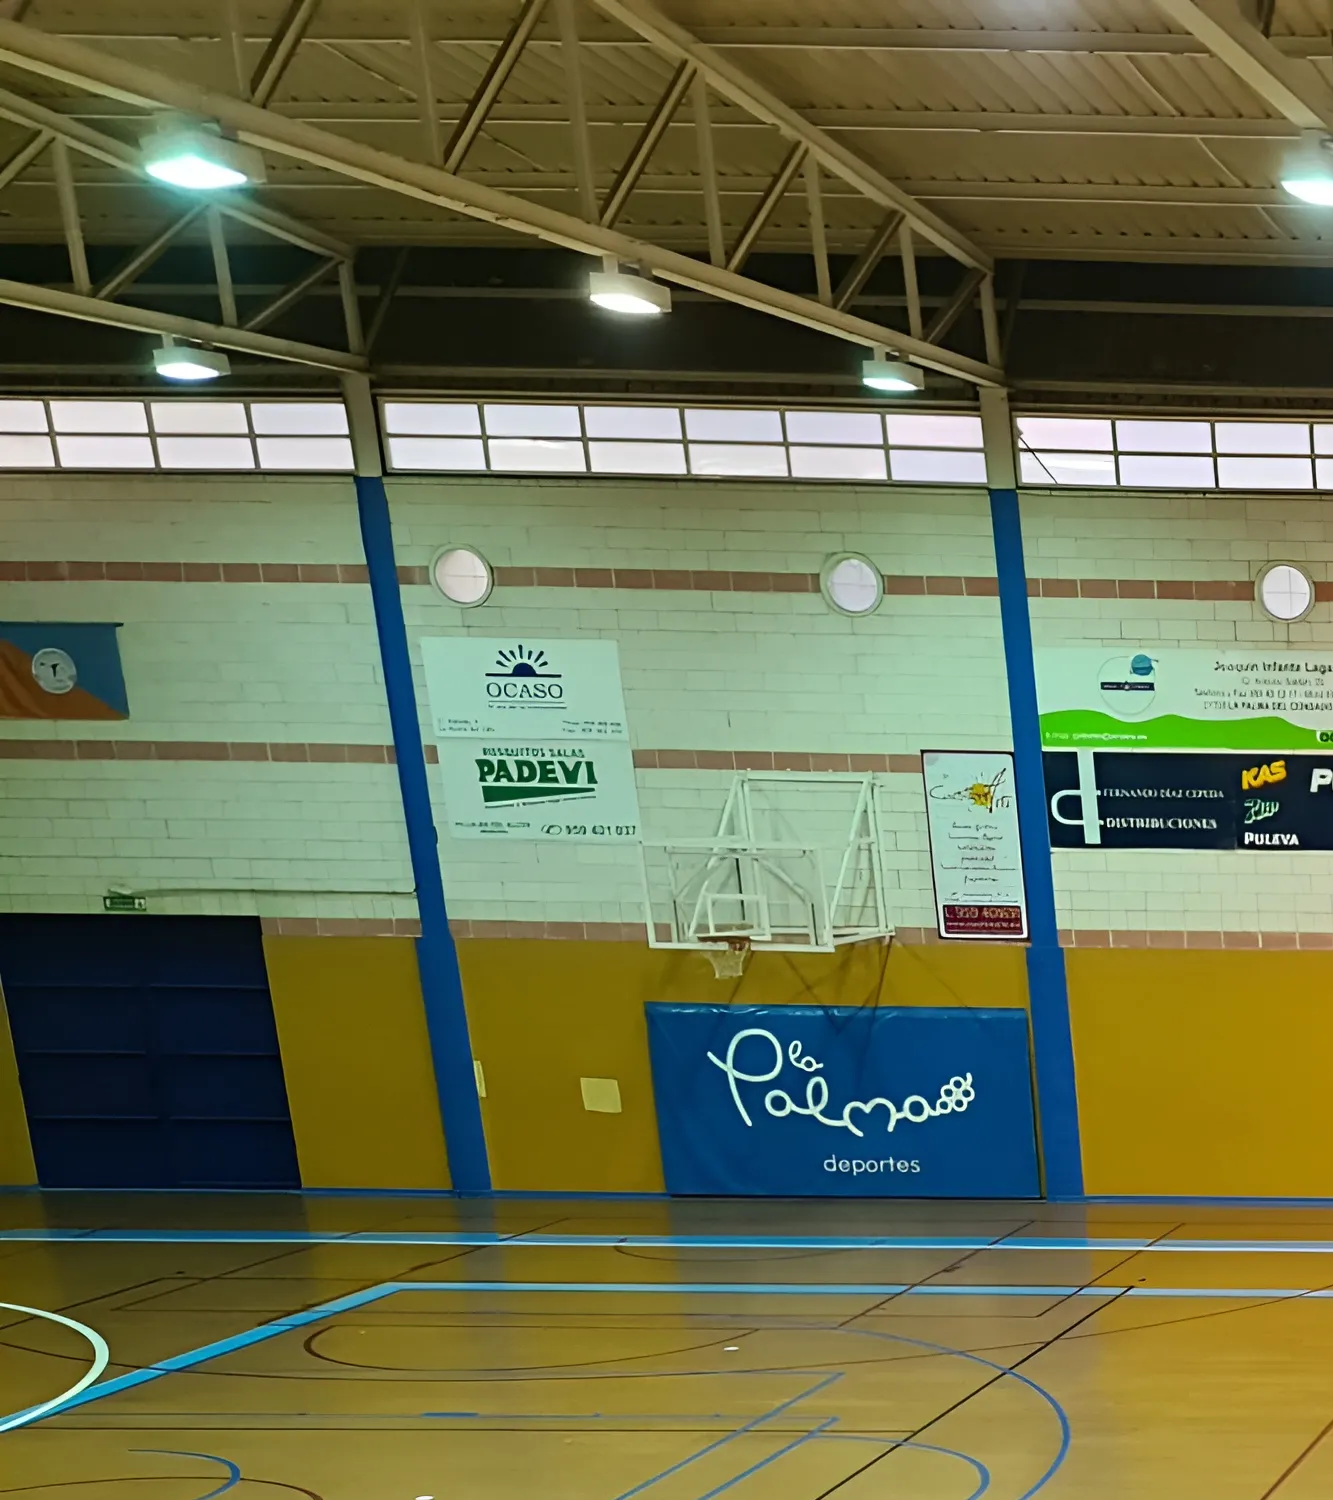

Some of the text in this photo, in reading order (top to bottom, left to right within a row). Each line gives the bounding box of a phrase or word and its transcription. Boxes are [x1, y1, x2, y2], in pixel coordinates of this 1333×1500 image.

[486, 682, 564, 699] OCASO
[475, 758, 598, 785] PADEVI
[1242, 760, 1288, 791] KAS
[1106, 817, 1218, 830] DISTRIBUCIONES
[823, 1154, 921, 1176] deportes
